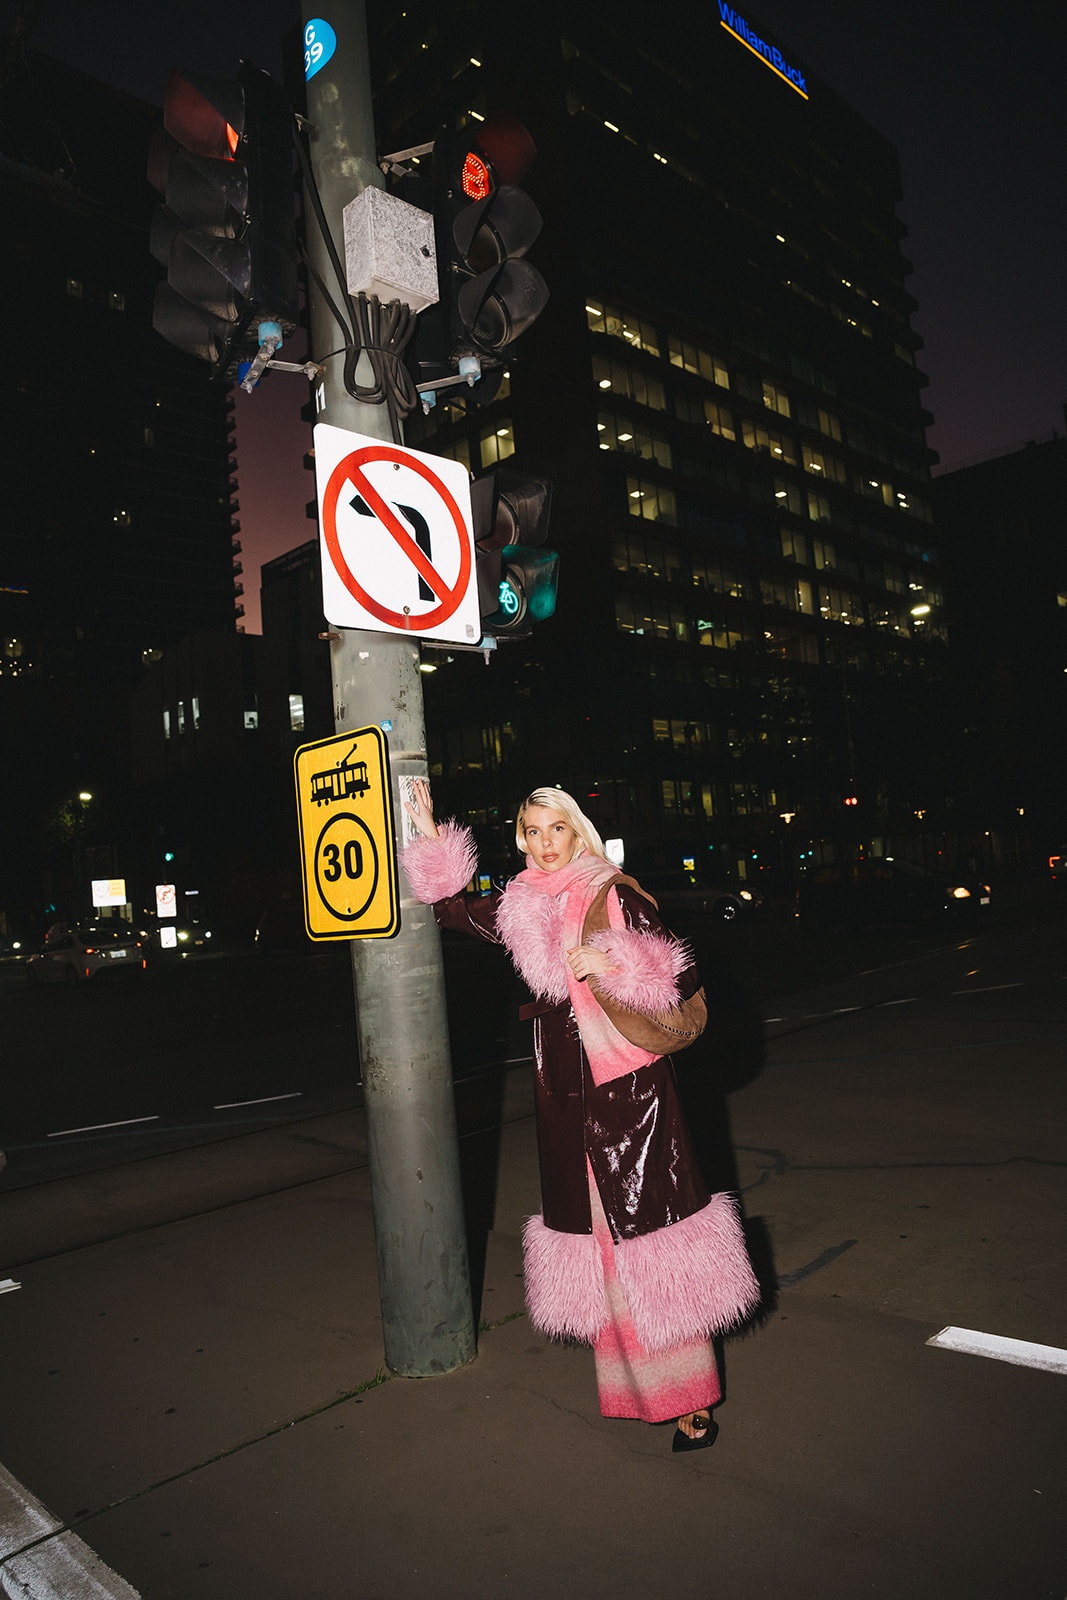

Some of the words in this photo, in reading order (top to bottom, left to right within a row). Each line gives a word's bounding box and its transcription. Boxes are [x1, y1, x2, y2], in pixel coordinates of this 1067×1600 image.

[305, 24, 315, 46] G
[304, 42, 323, 72] 39
[323, 840, 363, 882] 30
